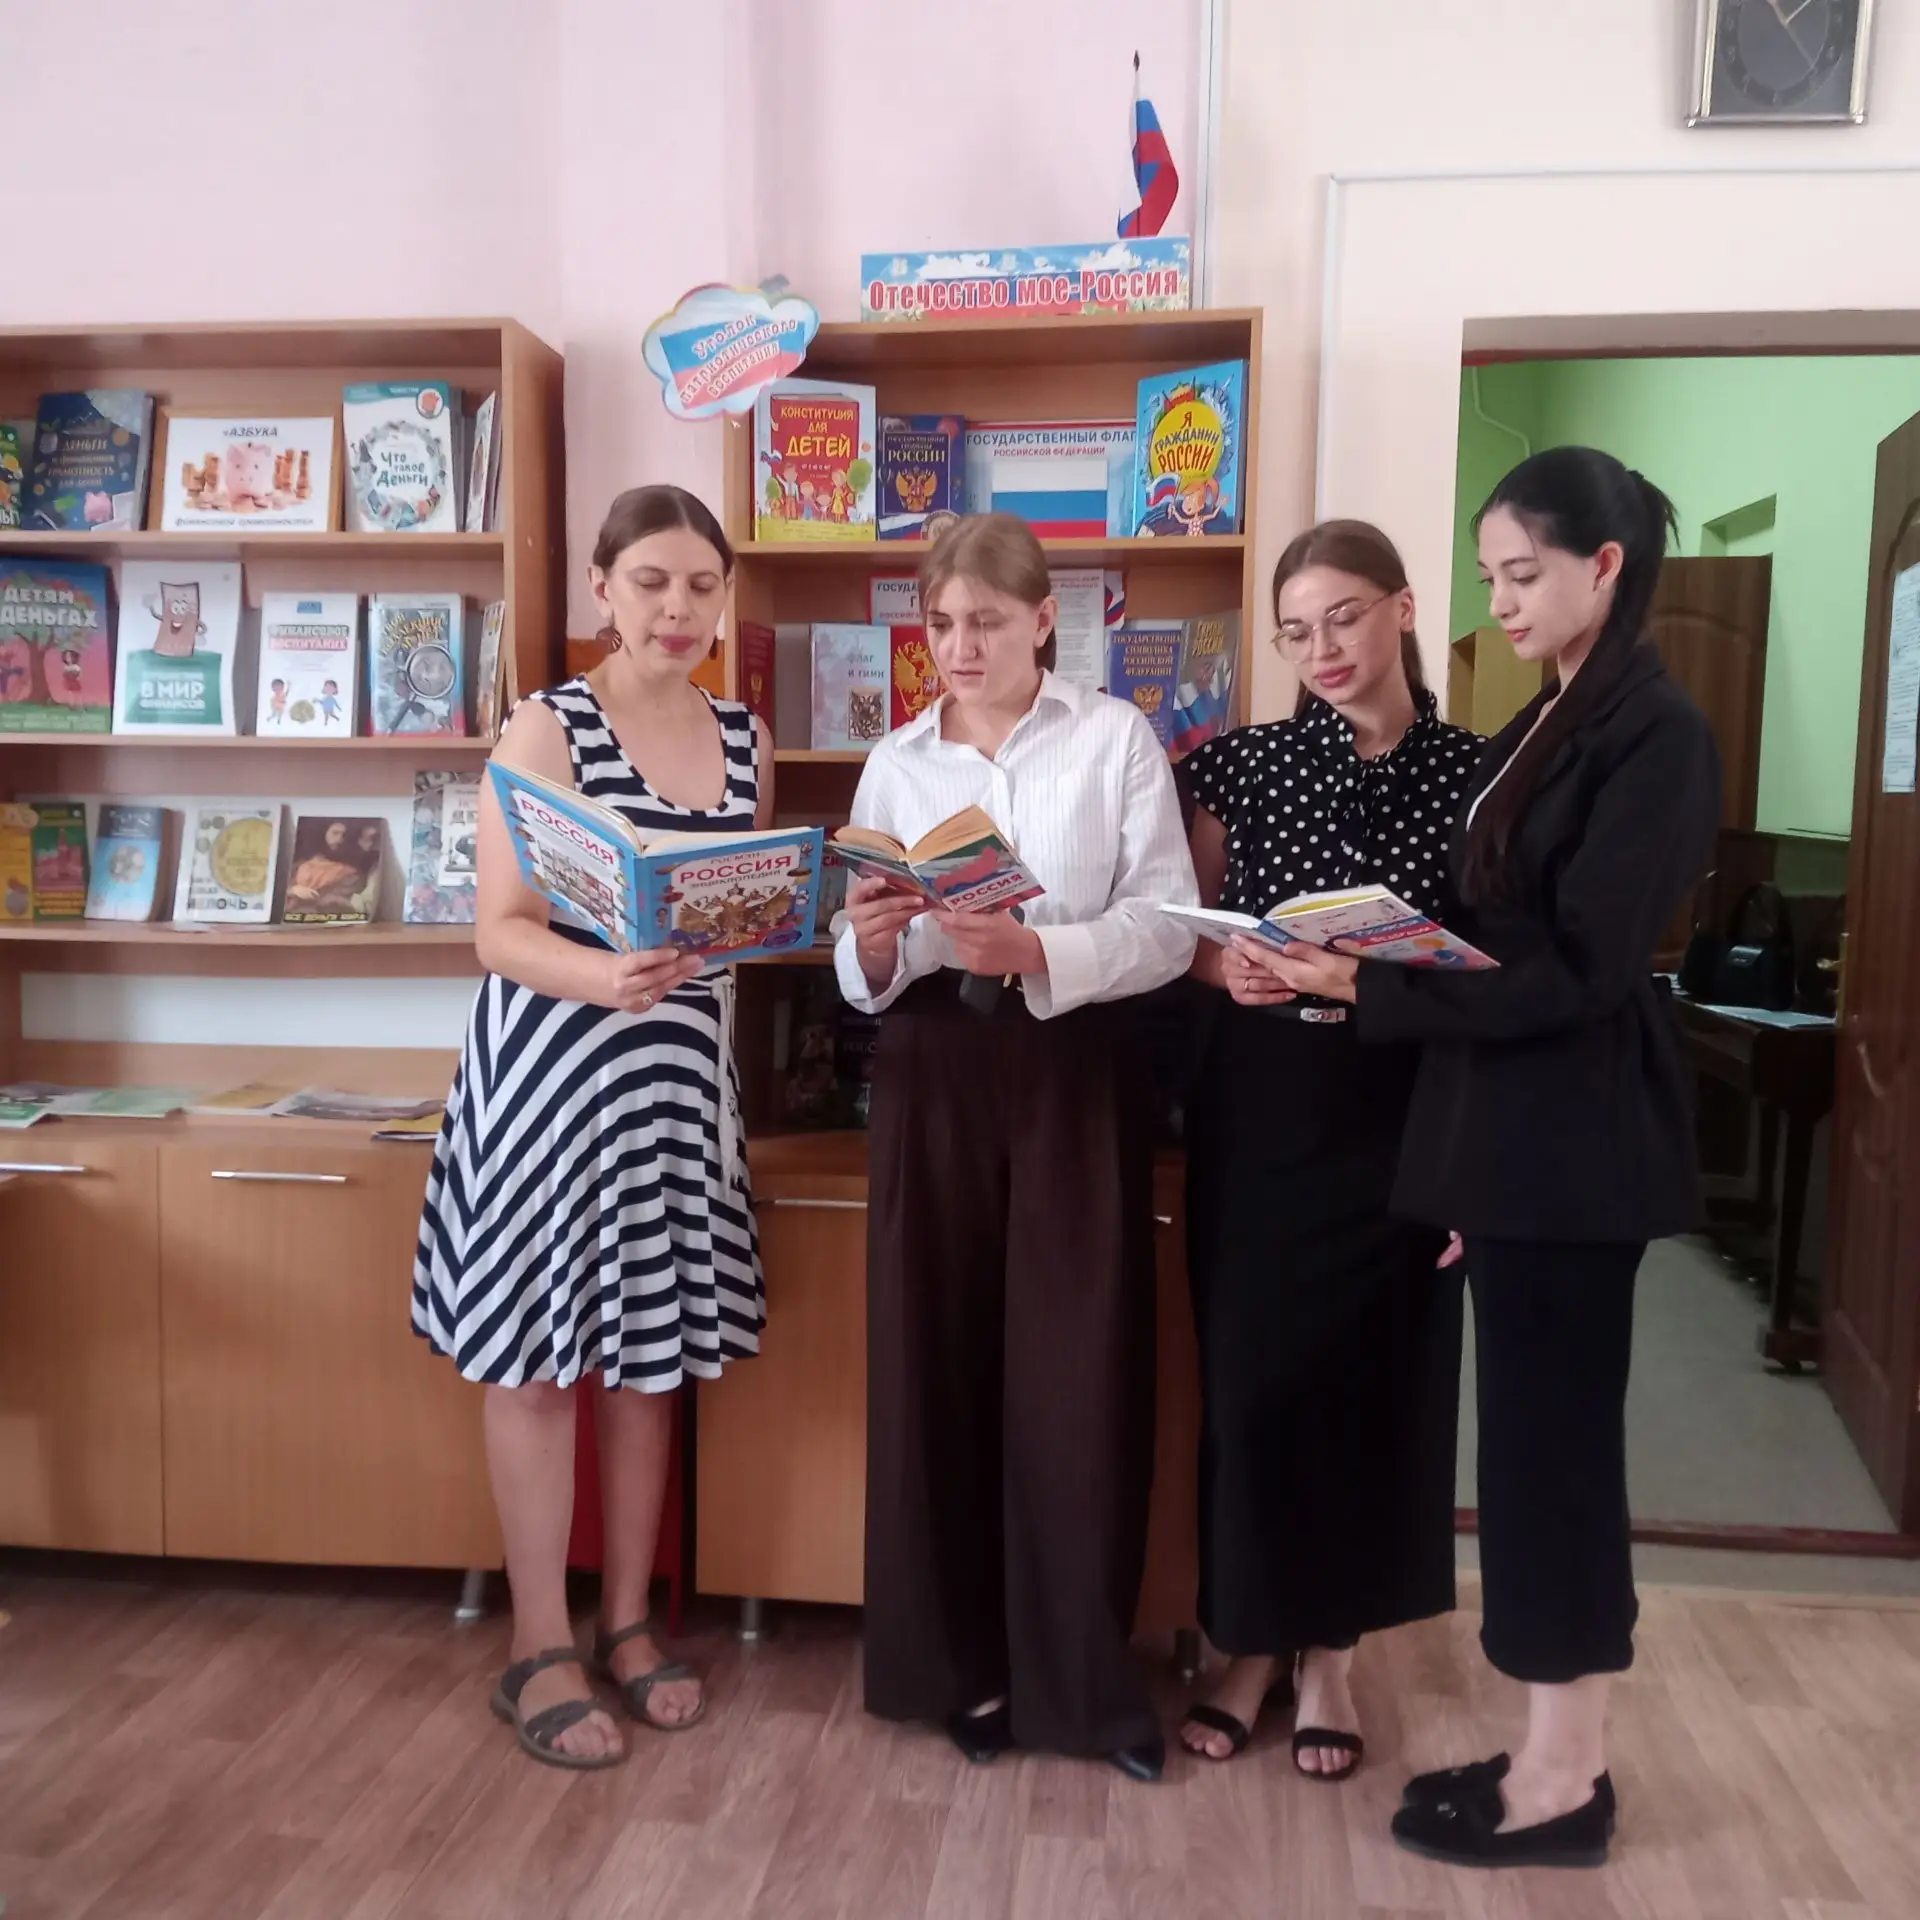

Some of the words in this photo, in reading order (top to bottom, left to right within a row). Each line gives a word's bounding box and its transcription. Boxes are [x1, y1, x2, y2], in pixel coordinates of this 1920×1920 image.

[869, 279, 1008, 311] Отечество
[1017, 269, 1179, 307] мое-Россия
[692, 314, 757, 359] Уголок
[680, 319, 797, 403] патриотического
[708, 342, 779, 397] воспитания
[781, 406, 854, 420] КОНСТИТУЦИЯ
[1181, 411, 1193, 429] Я
[807, 422, 828, 433] ДЛЯ
[966, 431, 1097, 446] ГОСУДАРСТВЕННЫЙ
[1101, 429, 1137, 443] ФЛАГ
[785, 433, 851, 458] ДЕТЕЙ
[1154, 428, 1220, 454] ГРАЖДАНИН
[381, 452, 407, 466] Что
[888, 450, 945, 463] РОССИИ
[993, 447, 1051, 457] РОССИЙСКОЙ
[1053, 447, 1106, 457] ФЕДЕРАЦИИ
[1157, 444, 1215, 473] РОССИИ
[393, 462, 425, 473] такое
[377, 470, 428, 488] Деньги
[4, 587, 74, 604] ДЕТЯМ
[0, 605, 98, 629] ДЕНЬГАХ
[141, 681, 154, 699] В
[157, 680, 205, 699] МИР
[520, 799, 614, 865] РОССИЯ
[680, 855, 792, 884] РОССИЯ
[951, 872, 1023, 906] РОССИЯ
